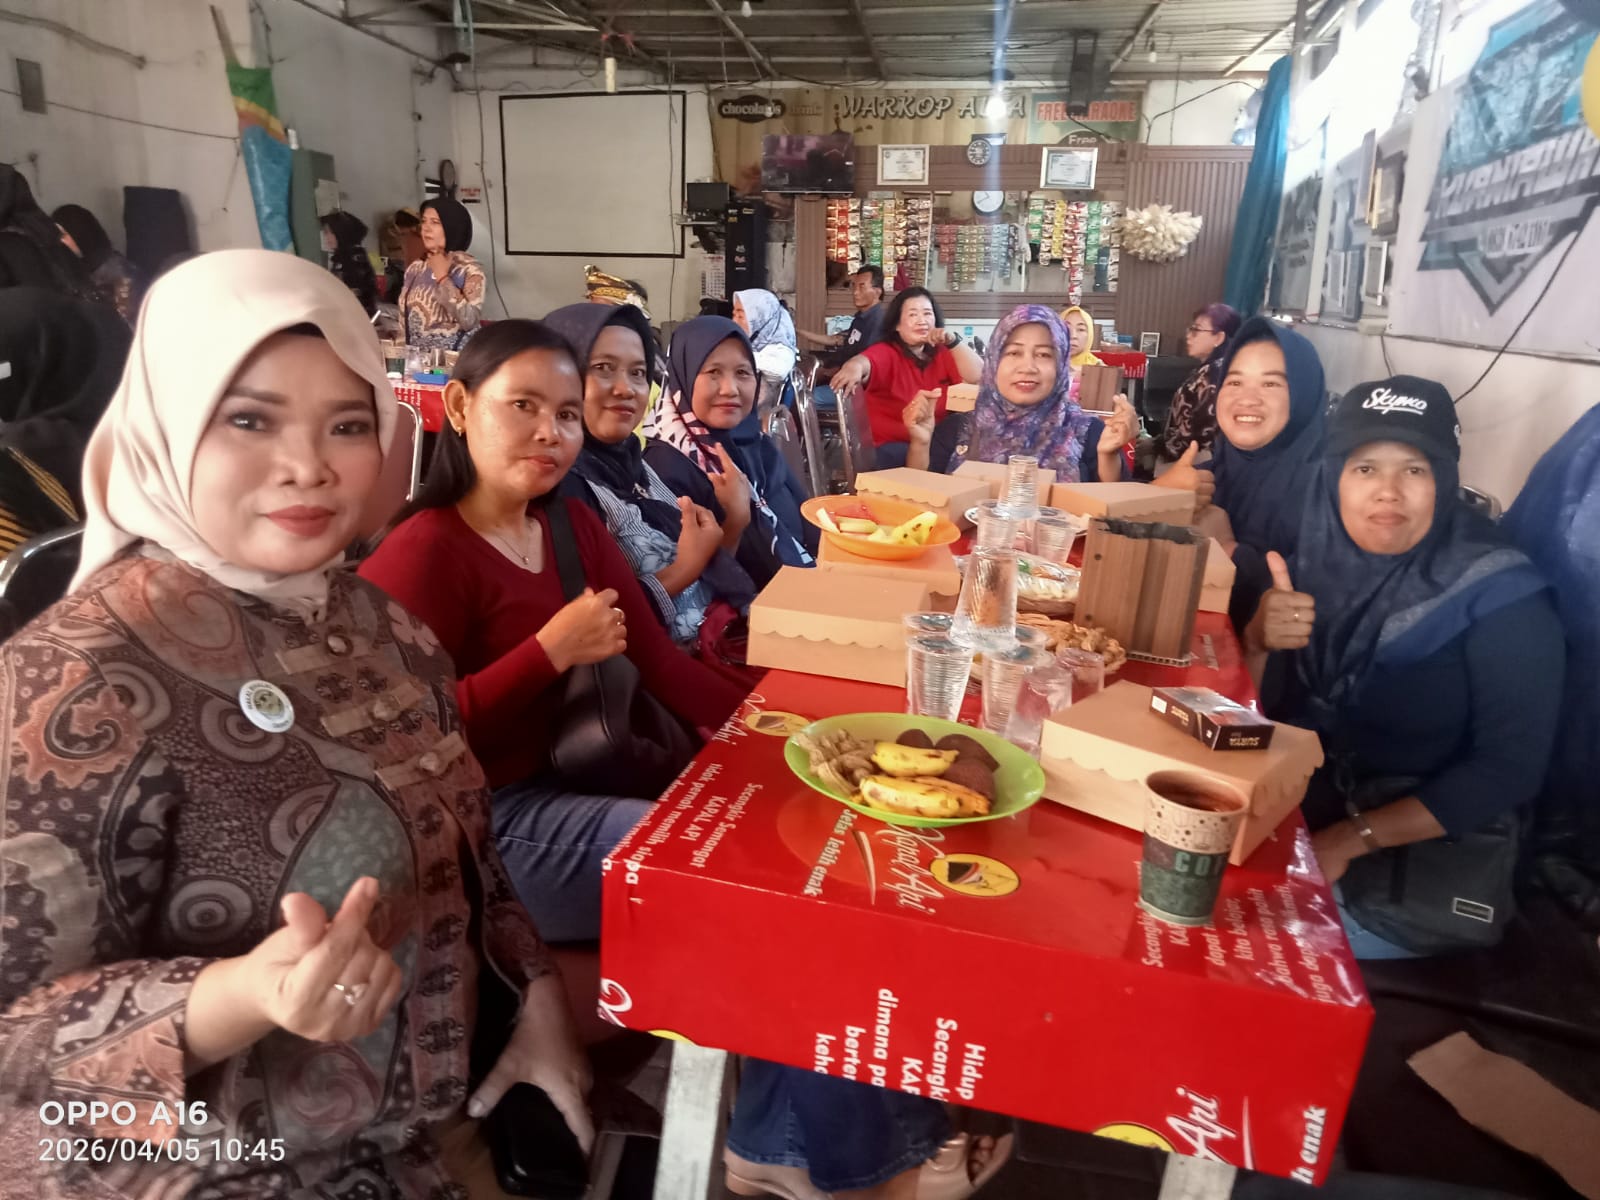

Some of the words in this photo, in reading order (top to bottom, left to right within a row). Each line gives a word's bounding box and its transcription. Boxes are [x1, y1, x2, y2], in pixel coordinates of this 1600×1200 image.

[843, 96, 953, 120] WARKOP
[1036, 101, 1069, 122] FREE
[1070, 101, 1137, 122] RAOKE
[675, 781, 706, 810] pernah
[693, 795, 728, 823] KAPAL
[725, 782, 764, 820] Secangkir
[644, 810, 683, 845] memilih
[679, 823, 705, 842] API
[833, 808, 858, 835] Jelas
[689, 820, 737, 868] Semangat
[821, 836, 846, 867] lebih
[875, 821, 946, 878] Kapal
[623, 846, 654, 885] siapa
[803, 865, 829, 898] enak
[881, 866, 945, 915] Api
[1260, 915, 1280, 941] rasa
[1200, 931, 1227, 967] dapat
[1233, 938, 1255, 961] kita
[873, 987, 900, 1061] dimana
[955, 1042, 987, 1101] Hidup
[1165, 1084, 1238, 1167] Api
[1299, 1104, 1327, 1165] enak
